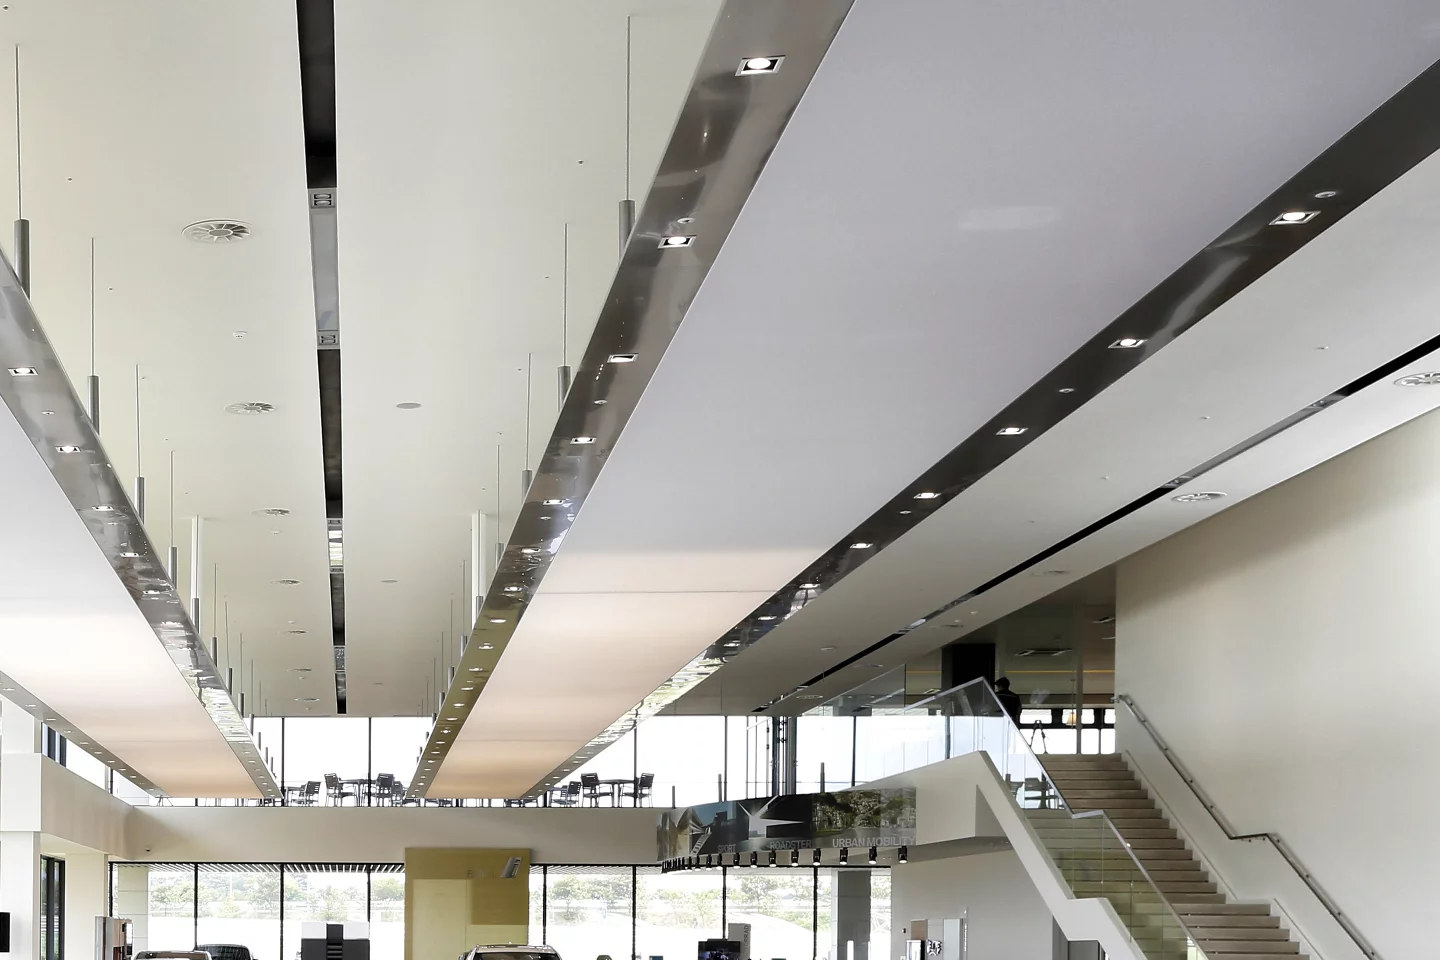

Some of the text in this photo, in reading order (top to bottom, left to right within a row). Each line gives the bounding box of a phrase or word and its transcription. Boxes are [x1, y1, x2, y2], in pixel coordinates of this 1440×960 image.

[769, 839, 812, 850] ROADSTER
[832, 836, 917, 848] URBAN MOBILITY
[717, 843, 737, 854] SPORT
